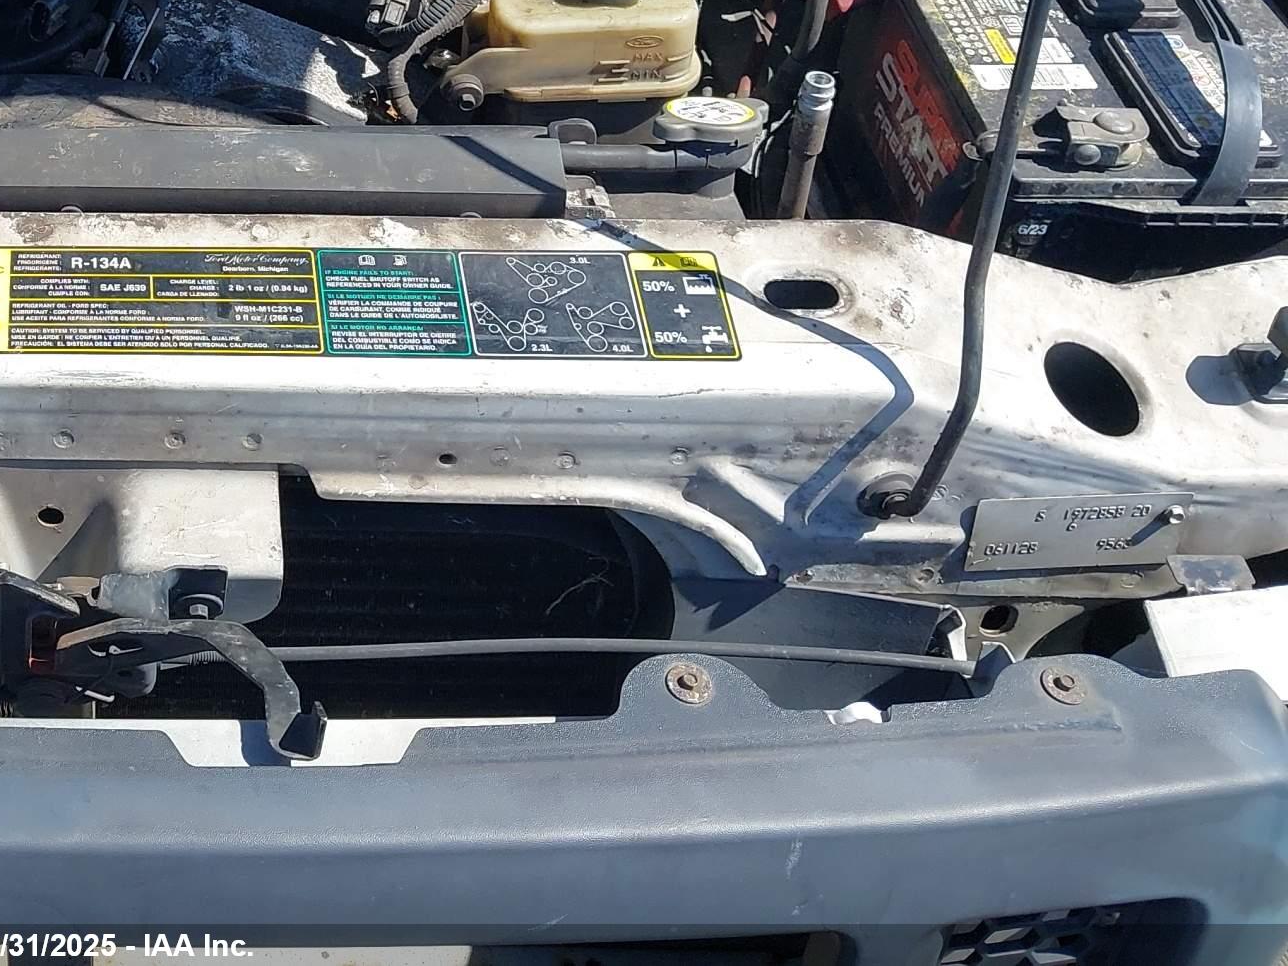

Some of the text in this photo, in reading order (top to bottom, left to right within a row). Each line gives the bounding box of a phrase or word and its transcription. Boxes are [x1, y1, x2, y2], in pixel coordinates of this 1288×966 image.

[875, 51, 950, 183] START
[1017, 224, 1048, 235] 6/23
[70, 257, 132, 269] R-134A
[204, 254, 310, 266] Ford Motor Company
[569, 256, 591, 264] 3.0L
[228, 284, 308, 293] 2 lb 1 oz (0.94 kg)
[642, 280, 675, 292] 50%
[654, 331, 688, 343] 50%
[531, 344, 553, 352] 2.3L
[612, 344, 634, 352] 4.0L
[1130, 504, 1152, 518] 20
[984, 541, 1039, 556] 061128
